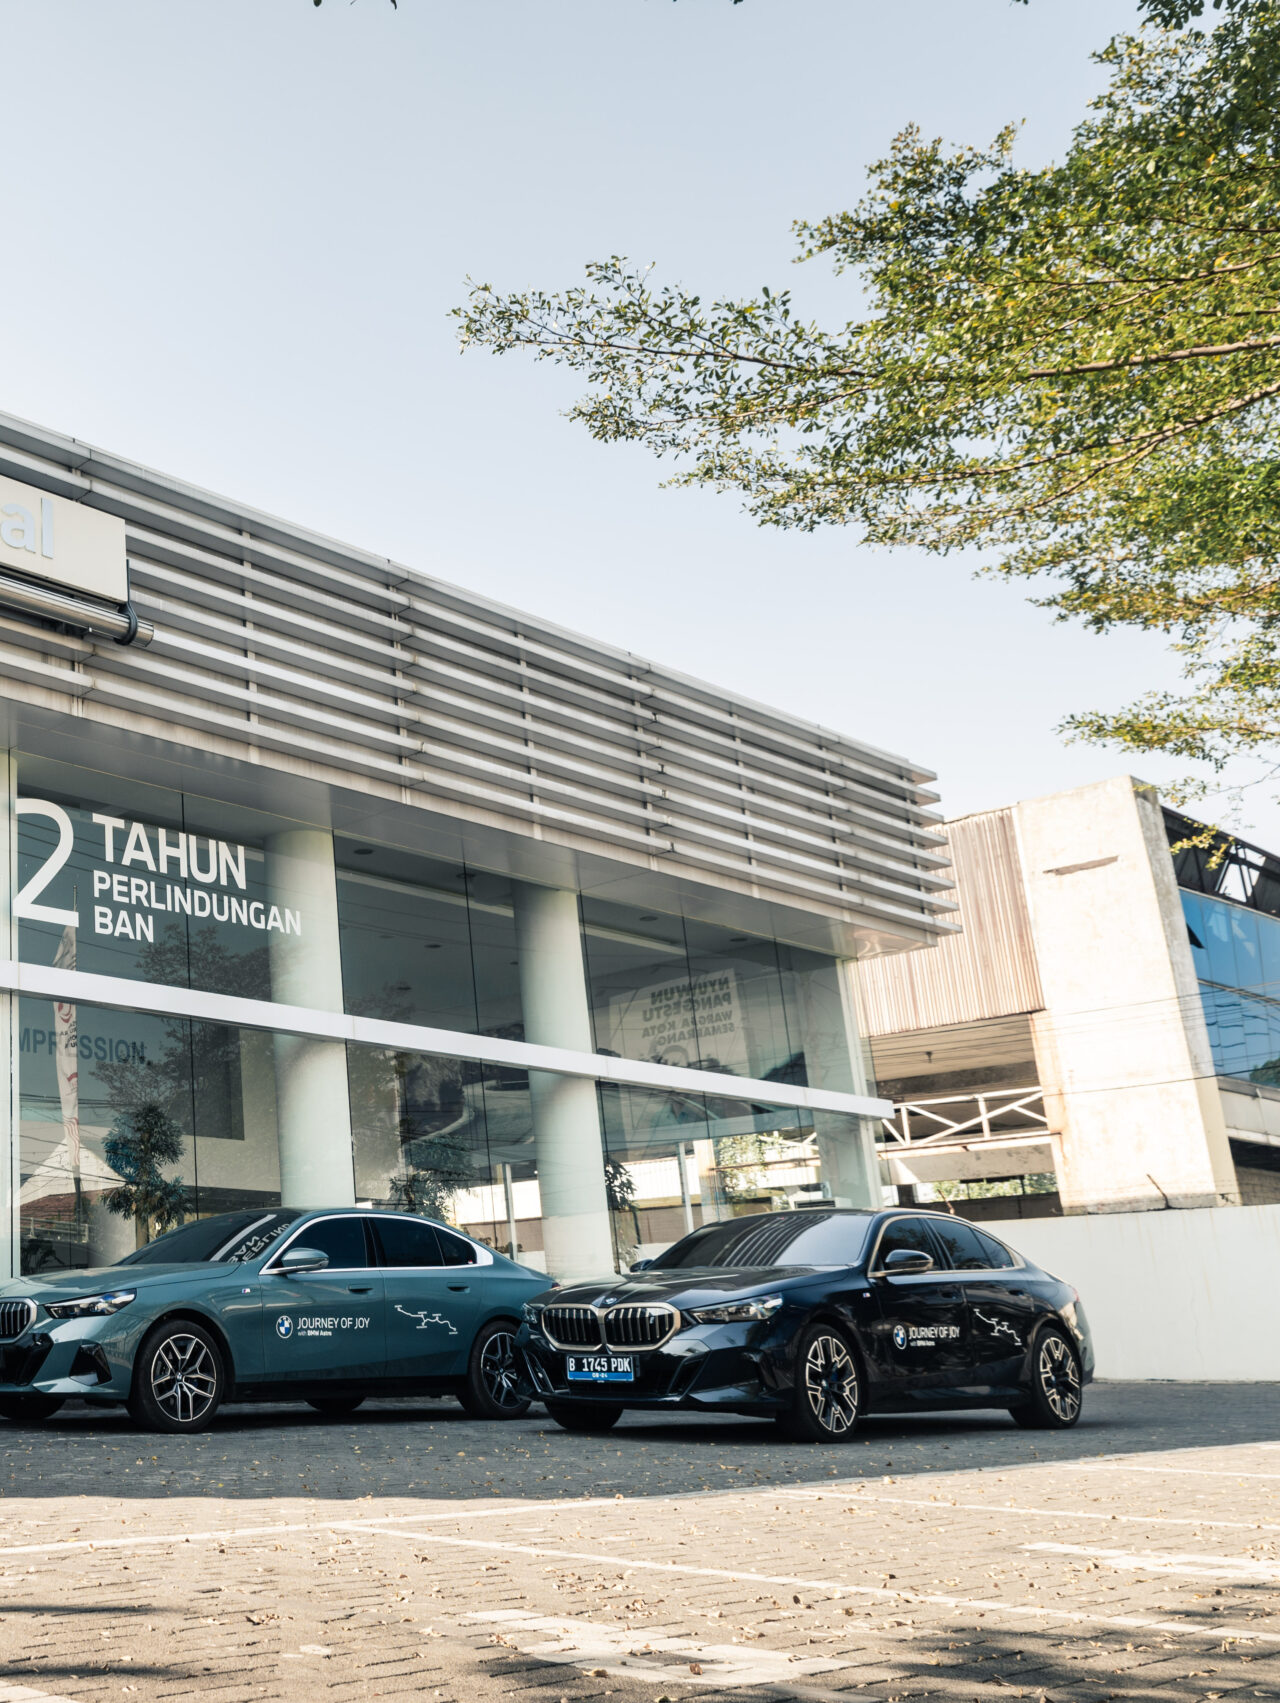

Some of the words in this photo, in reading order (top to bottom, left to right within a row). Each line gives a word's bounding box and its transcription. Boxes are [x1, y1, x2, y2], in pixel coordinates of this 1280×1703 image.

[12, 797, 80, 928] 2
[92, 812, 247, 890] TAHUN
[93, 869, 302, 937] PERLINDUNGAN
[94, 905, 154, 943] BAN
[297, 1317, 339, 1329] JOURNEY
[340, 1317, 353, 1328] OF
[354, 1317, 370, 1329] JOY
[908, 1327, 938, 1339] JOURNEY
[938, 1326, 948, 1338] OF
[949, 1326, 960, 1338] JOY
[569, 1358, 575, 1371] B
[582, 1358, 608, 1371] 1745
[611, 1358, 631, 1372] PDK
